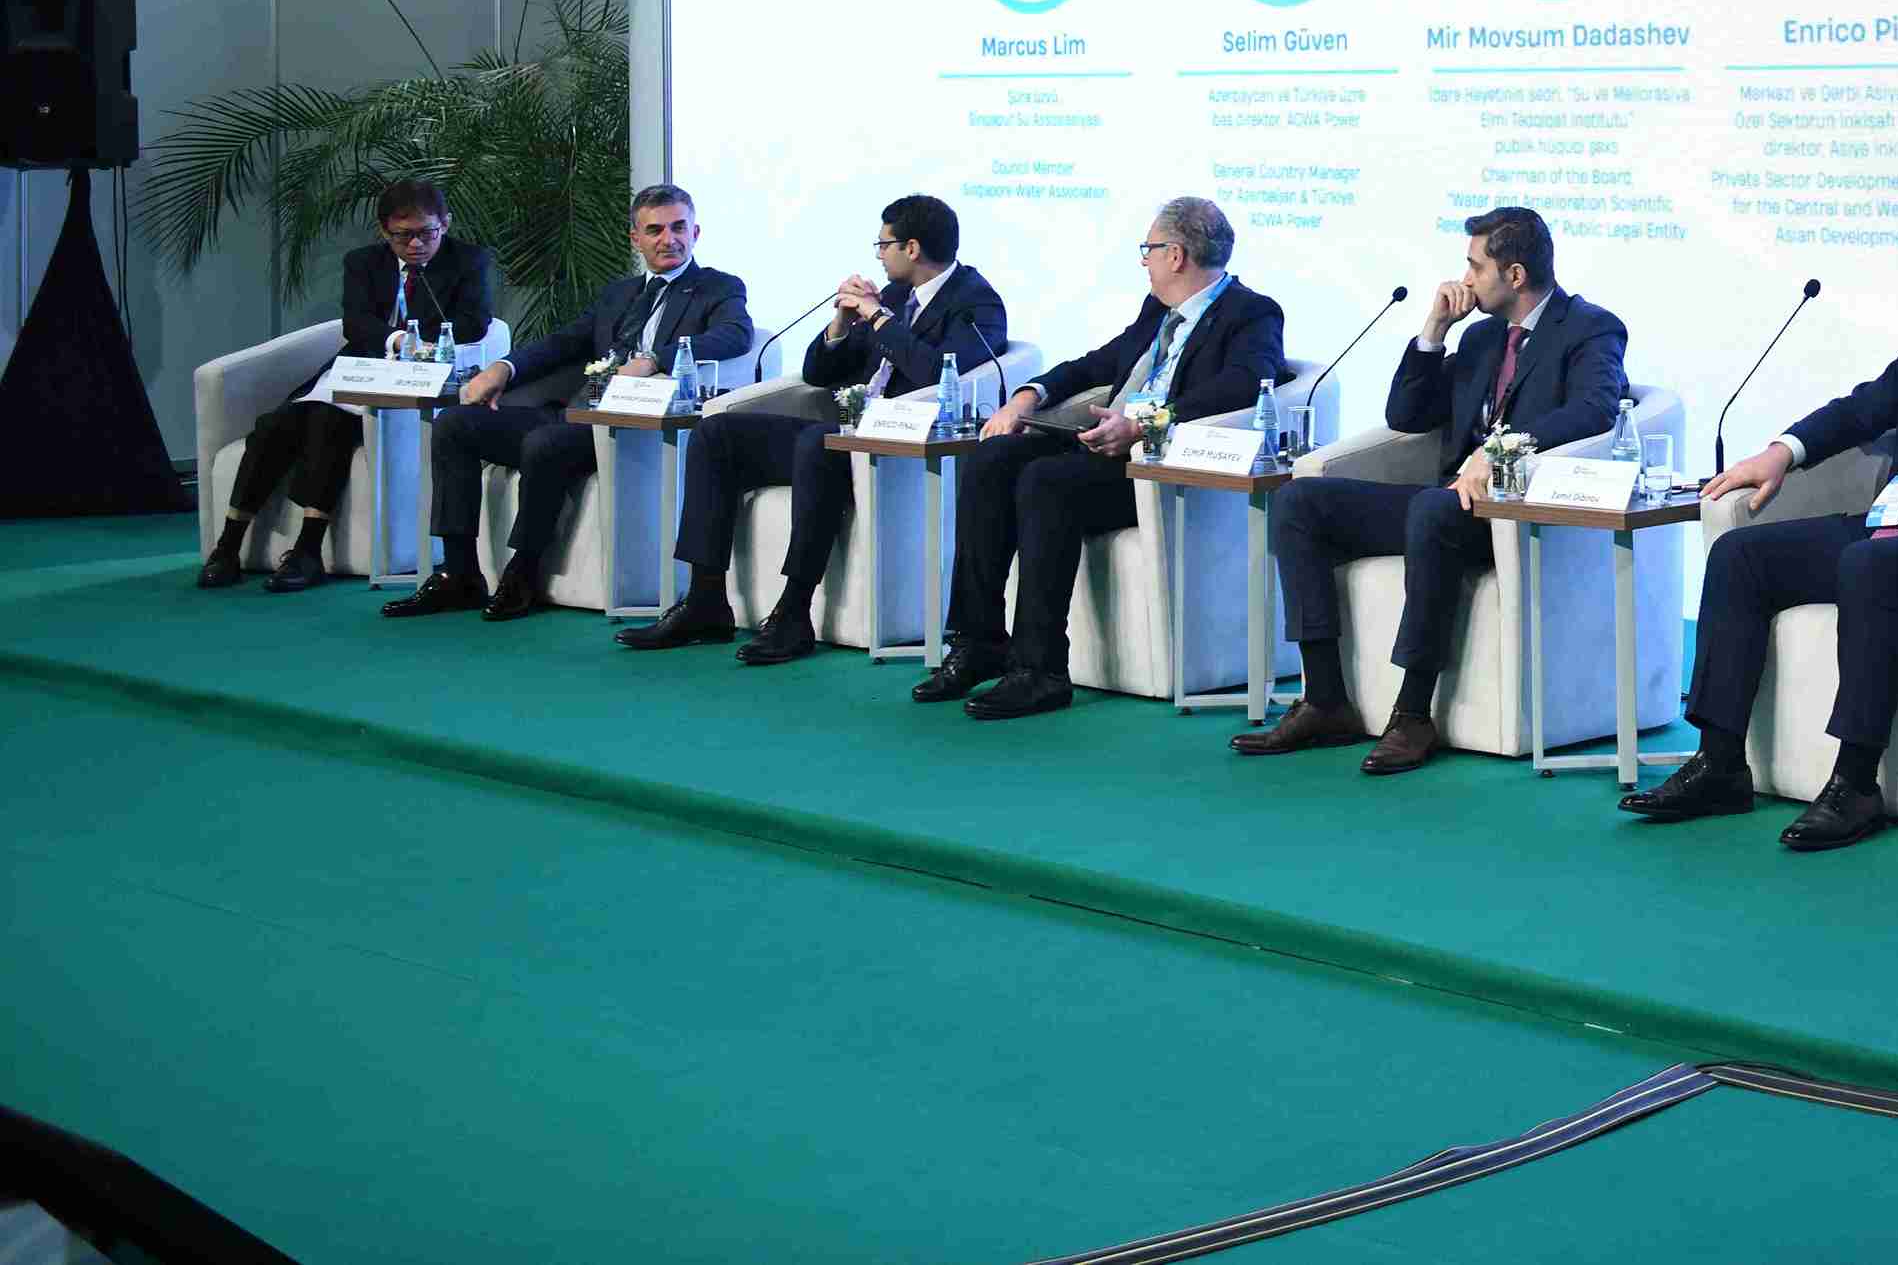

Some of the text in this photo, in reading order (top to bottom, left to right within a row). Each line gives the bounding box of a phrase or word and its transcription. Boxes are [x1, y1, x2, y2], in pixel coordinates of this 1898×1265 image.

[1223, 27, 1349, 52] Selim Güven
[1427, 23, 1690, 48] Mir Movsum Dadashev
[1784, 17, 1867, 44] Enrico
[981, 33, 1086, 56] Marcus Lim
